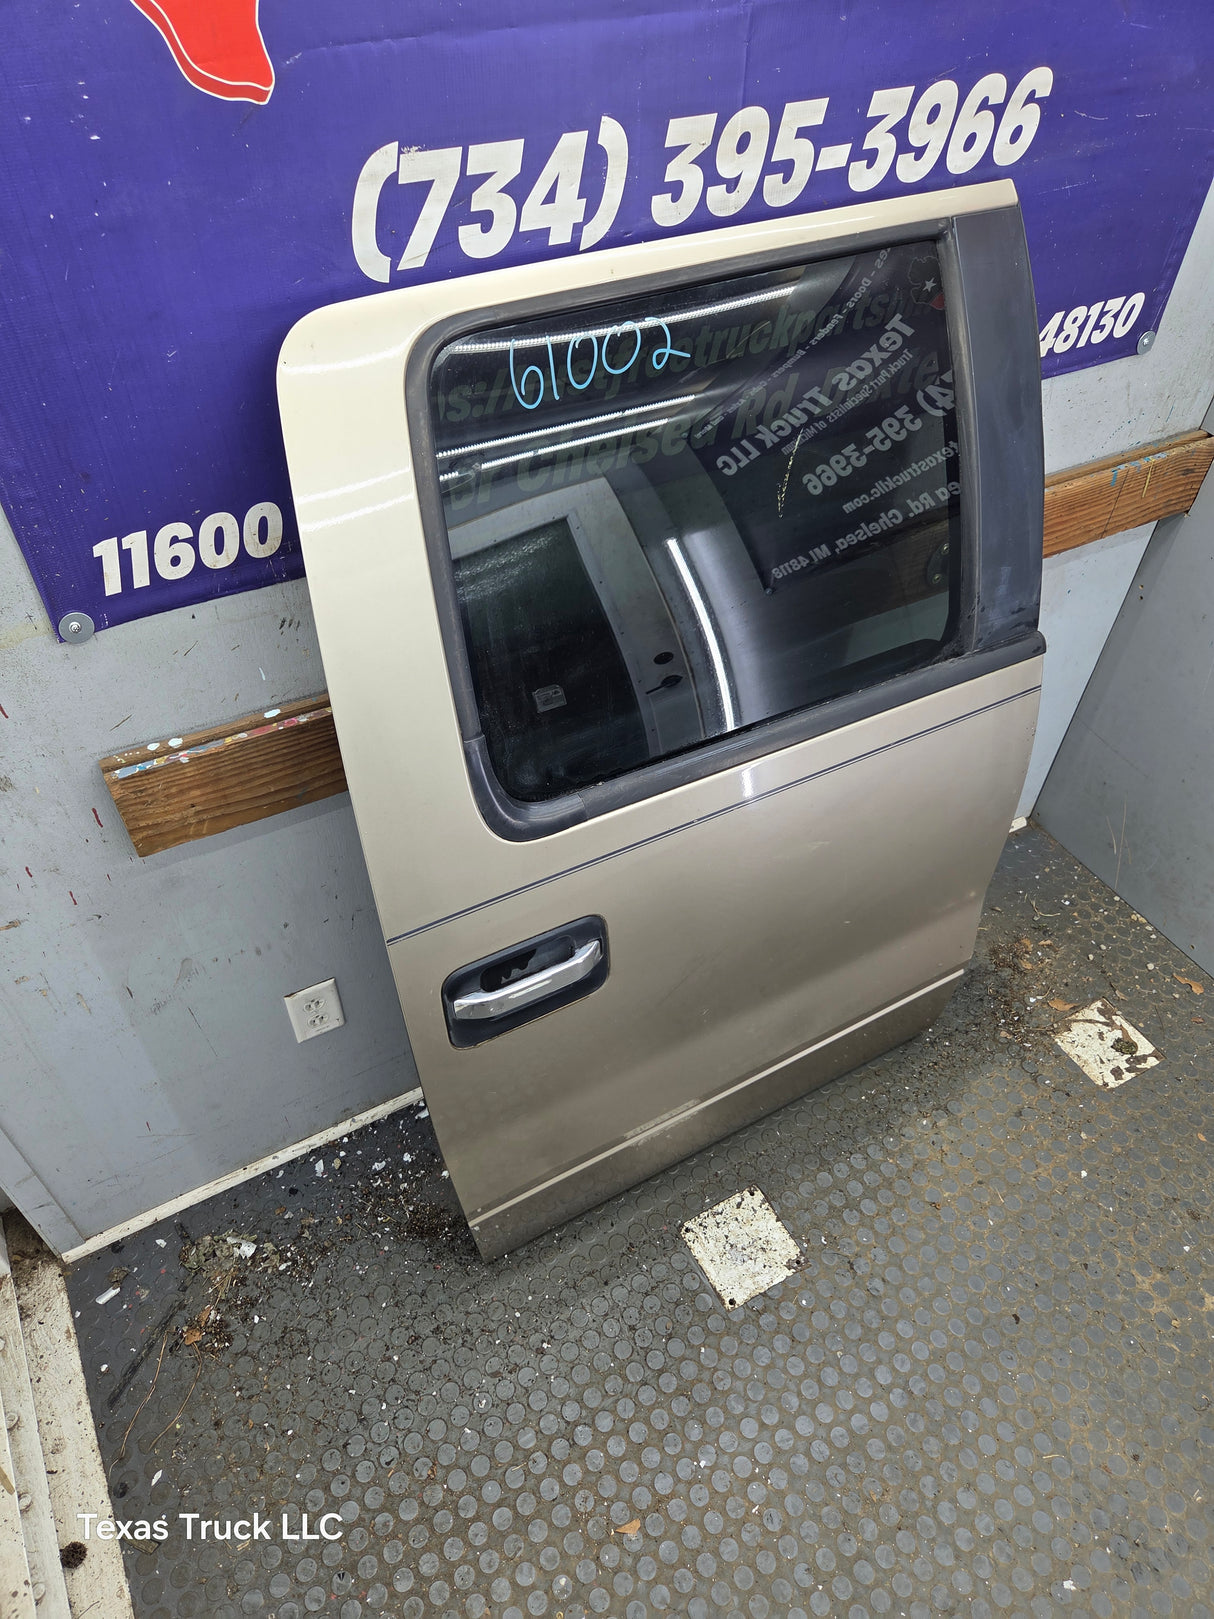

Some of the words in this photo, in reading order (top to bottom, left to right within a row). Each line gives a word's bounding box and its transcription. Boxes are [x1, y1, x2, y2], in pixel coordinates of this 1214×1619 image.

[352, 115, 629, 283] (734)
[651, 66, 1053, 228] 395-3966
[509, 317, 692, 410] 61002
[1039, 292, 1145, 357] 48130
[732, 372, 799, 440] Rd
[93, 501, 283, 597] 11600
